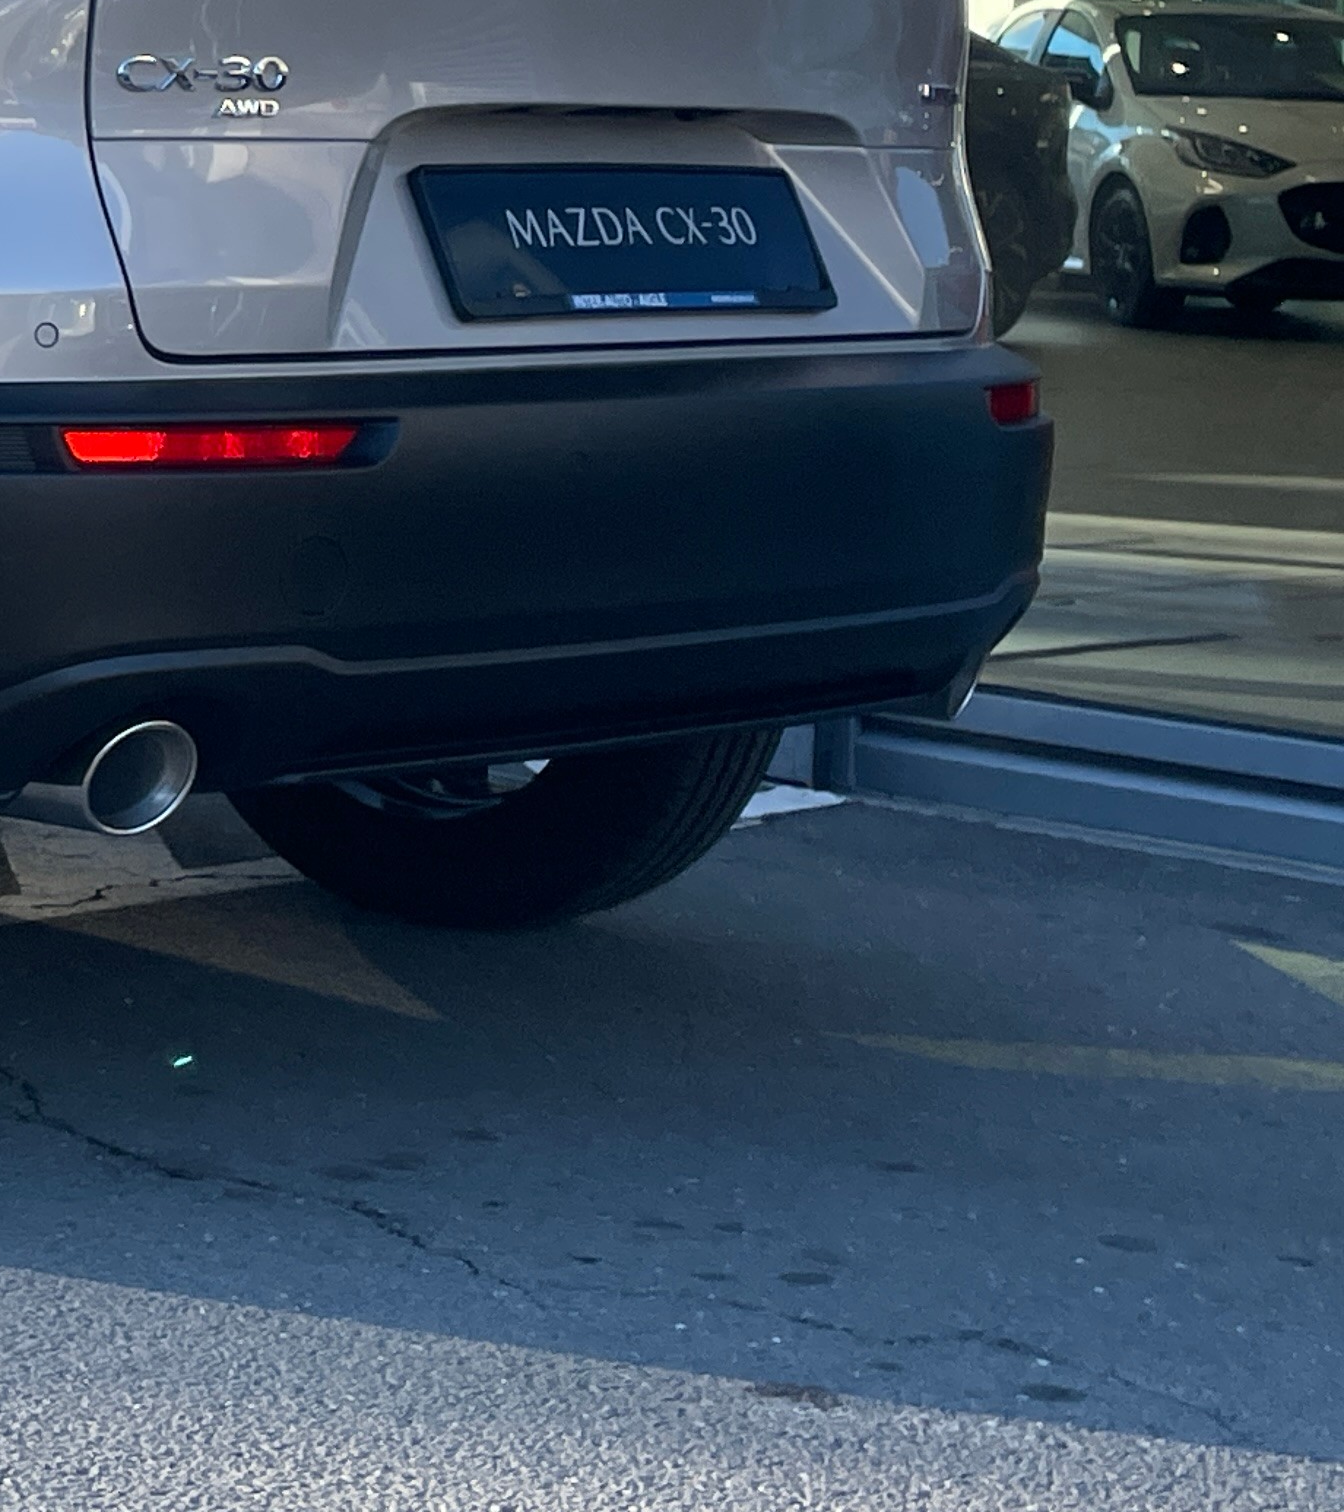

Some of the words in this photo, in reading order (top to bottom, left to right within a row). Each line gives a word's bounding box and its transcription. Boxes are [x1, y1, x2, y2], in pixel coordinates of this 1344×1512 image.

[116, 54, 290, 92] CX-30
[216, 98, 280, 118] AWD
[505, 206, 653, 249] MAZDA
[655, 206, 758, 245] CX-30
